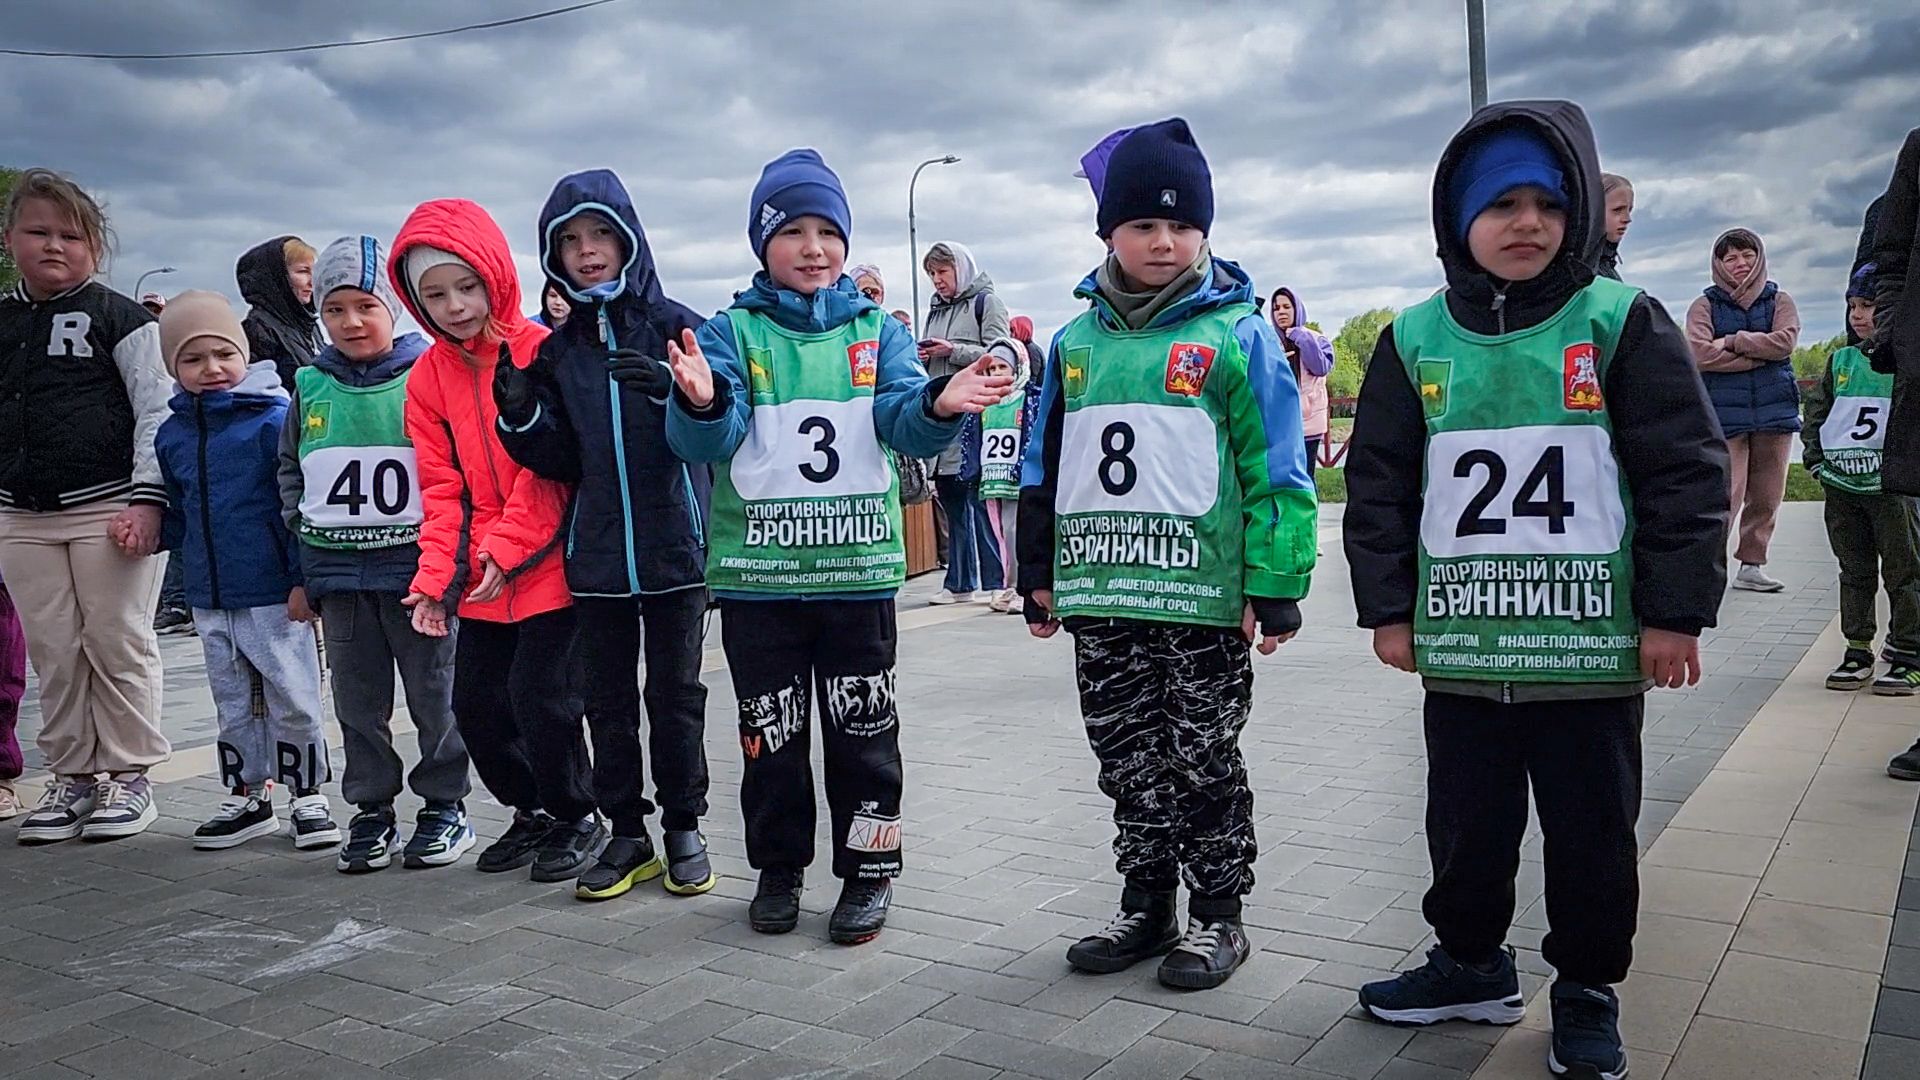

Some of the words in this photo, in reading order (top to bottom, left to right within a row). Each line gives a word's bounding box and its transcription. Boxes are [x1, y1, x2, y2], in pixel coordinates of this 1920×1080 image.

[761, 211, 787, 240] adidas
[47, 311, 93, 357] R
[1850, 407, 1880, 440] 5
[798, 416, 840, 483] 3
[987, 434, 1016, 458] 29
[1098, 421, 1137, 496] 8
[326, 459, 410, 516] 40
[1453, 445, 1575, 538] 24
[745, 497, 851, 519] СПОРТИВНЫЙ
[855, 497, 886, 514] КЛУБ
[745, 513, 892, 547] БРОННИЦЫ
[1148, 517, 1195, 537] КЛУБ
[720, 556, 800, 571] #ЖИВУСПОРТОМ
[1430, 556, 1548, 583] СПОРТИВНЫЙ
[1554, 560, 1611, 581] КЛУБ
[1427, 581, 1613, 620] БРОННИЦЫ
